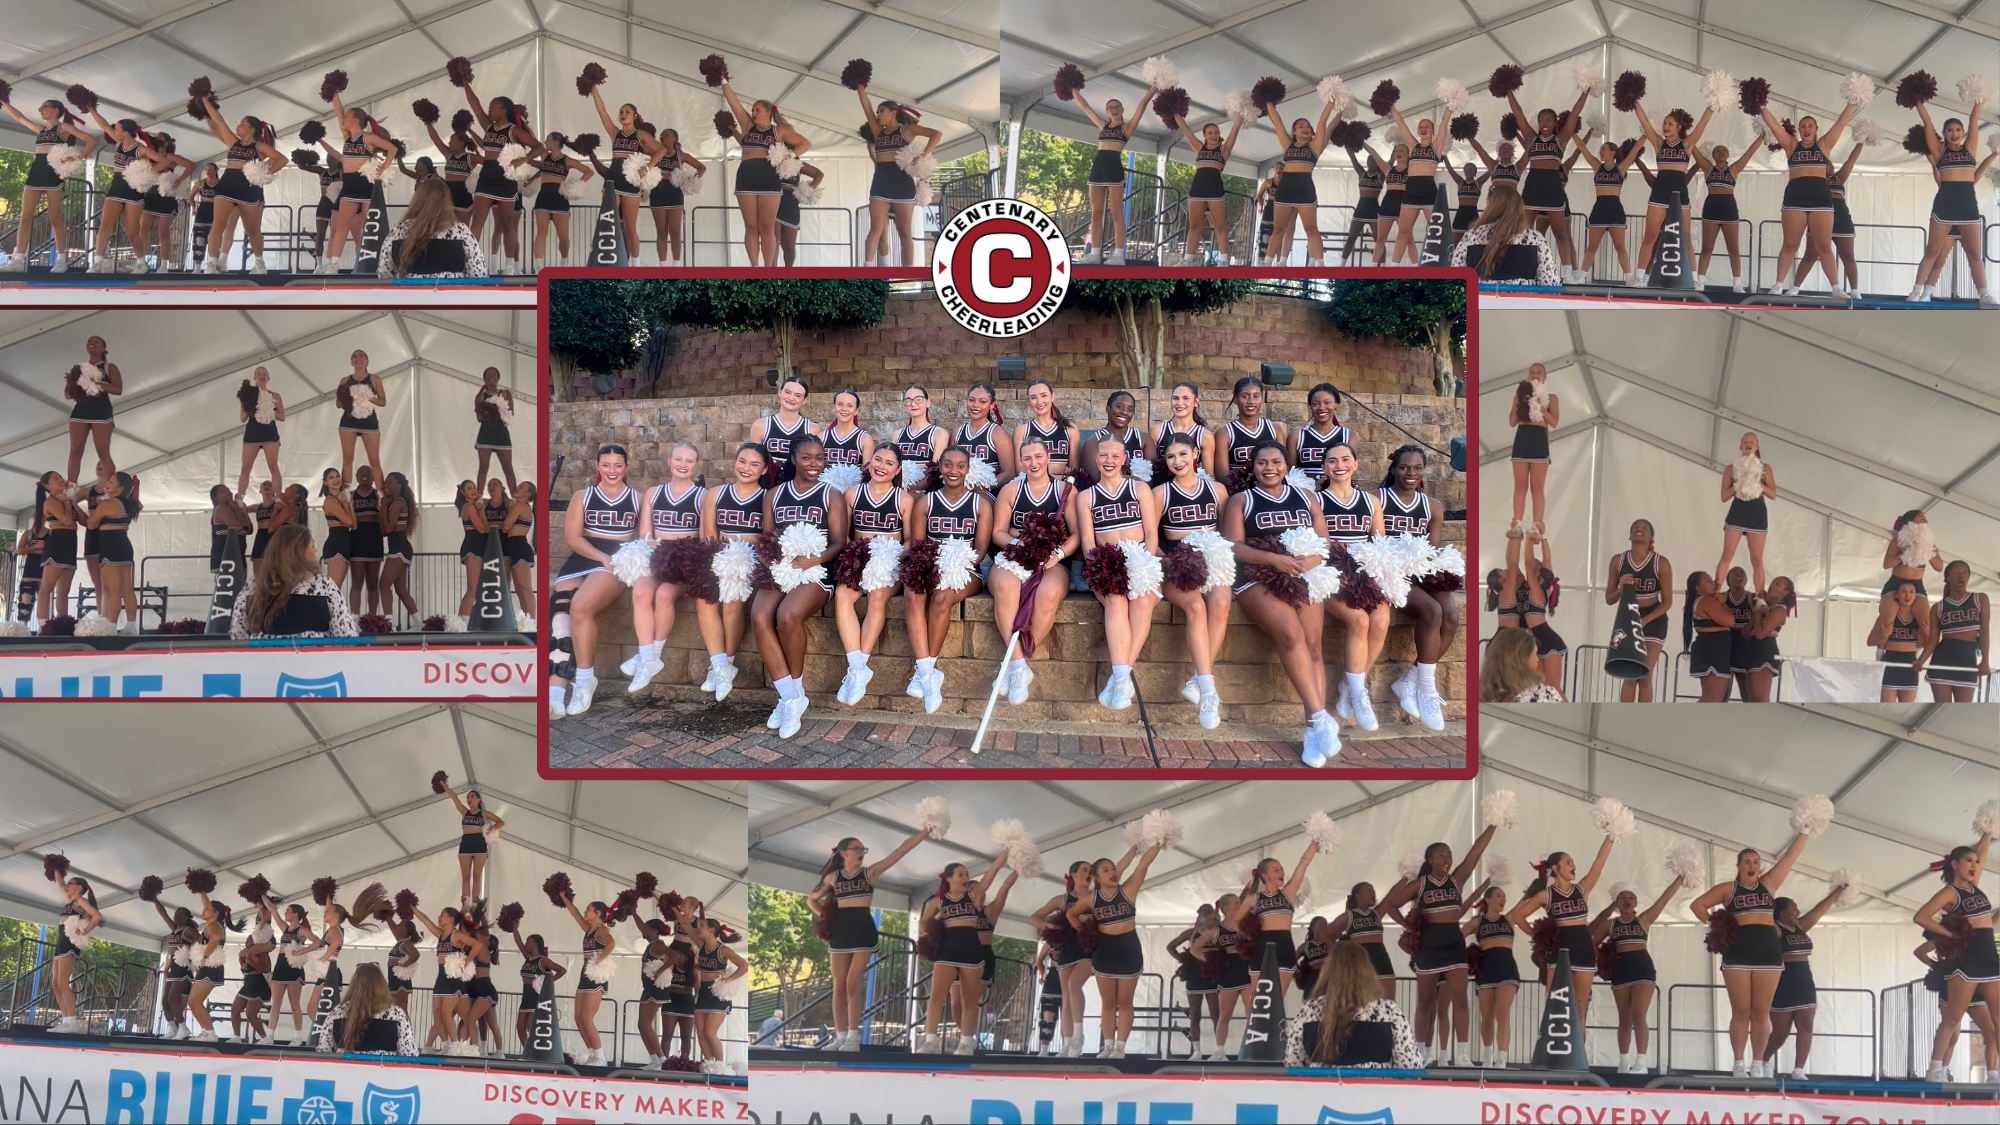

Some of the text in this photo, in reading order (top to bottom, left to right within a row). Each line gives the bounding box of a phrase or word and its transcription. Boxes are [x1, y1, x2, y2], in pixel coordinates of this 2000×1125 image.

[744, 133, 774, 146] CCLA
[1657, 148, 1687, 160] CCLA
[1791, 150, 1824, 162] CCLA
[1942, 152, 1974, 164] CCLA
[358, 208, 381, 262] CCLA
[597, 209, 617, 265] CCLA
[1420, 211, 1444, 265] CCLA
[1661, 221, 1681, 278] CCLA
[767, 438, 790, 453] CC
[898, 442, 930, 458] CLA
[1300, 447, 1324, 462] CC
[585, 509, 637, 527] CCLA
[653, 509, 697, 528] CCLA
[717, 508, 764, 529] CCLA
[774, 505, 823, 524] CCLA
[854, 509, 899, 530] CCLA
[1092, 501, 1141, 524] CCLA
[1168, 503, 1218, 523] CCLA
[1256, 509, 1312, 530] CCLA
[929, 516, 976, 535] CCLA
[1323, 514, 1372, 532] CCLA
[1383, 514, 1429, 534] CCLA
[211, 559, 236, 621] CCLA
[481, 557, 502, 620] CCLA
[1941, 608, 1980, 625] CCLA
[834, 879, 870, 893] CCLA
[1423, 888, 1459, 904] CCLA
[1734, 893, 1774, 909] CCLA
[942, 903, 975, 917] CCLA
[1095, 903, 1131, 919] CCLA
[1551, 900, 1587, 916] CCLA
[1612, 924, 1644, 938] CCLA
[312, 986, 335, 1035] CCLA
[1245, 978, 1274, 1045] CCLA
[534, 999, 553, 1051] CCLA
[1546, 986, 1572, 1055] CCLA
[484, 1083, 625, 1112] DISCOVERY
[634, 1095, 725, 1119] MAKER
[1481, 1101, 1671, 1125] DISCOVERY
